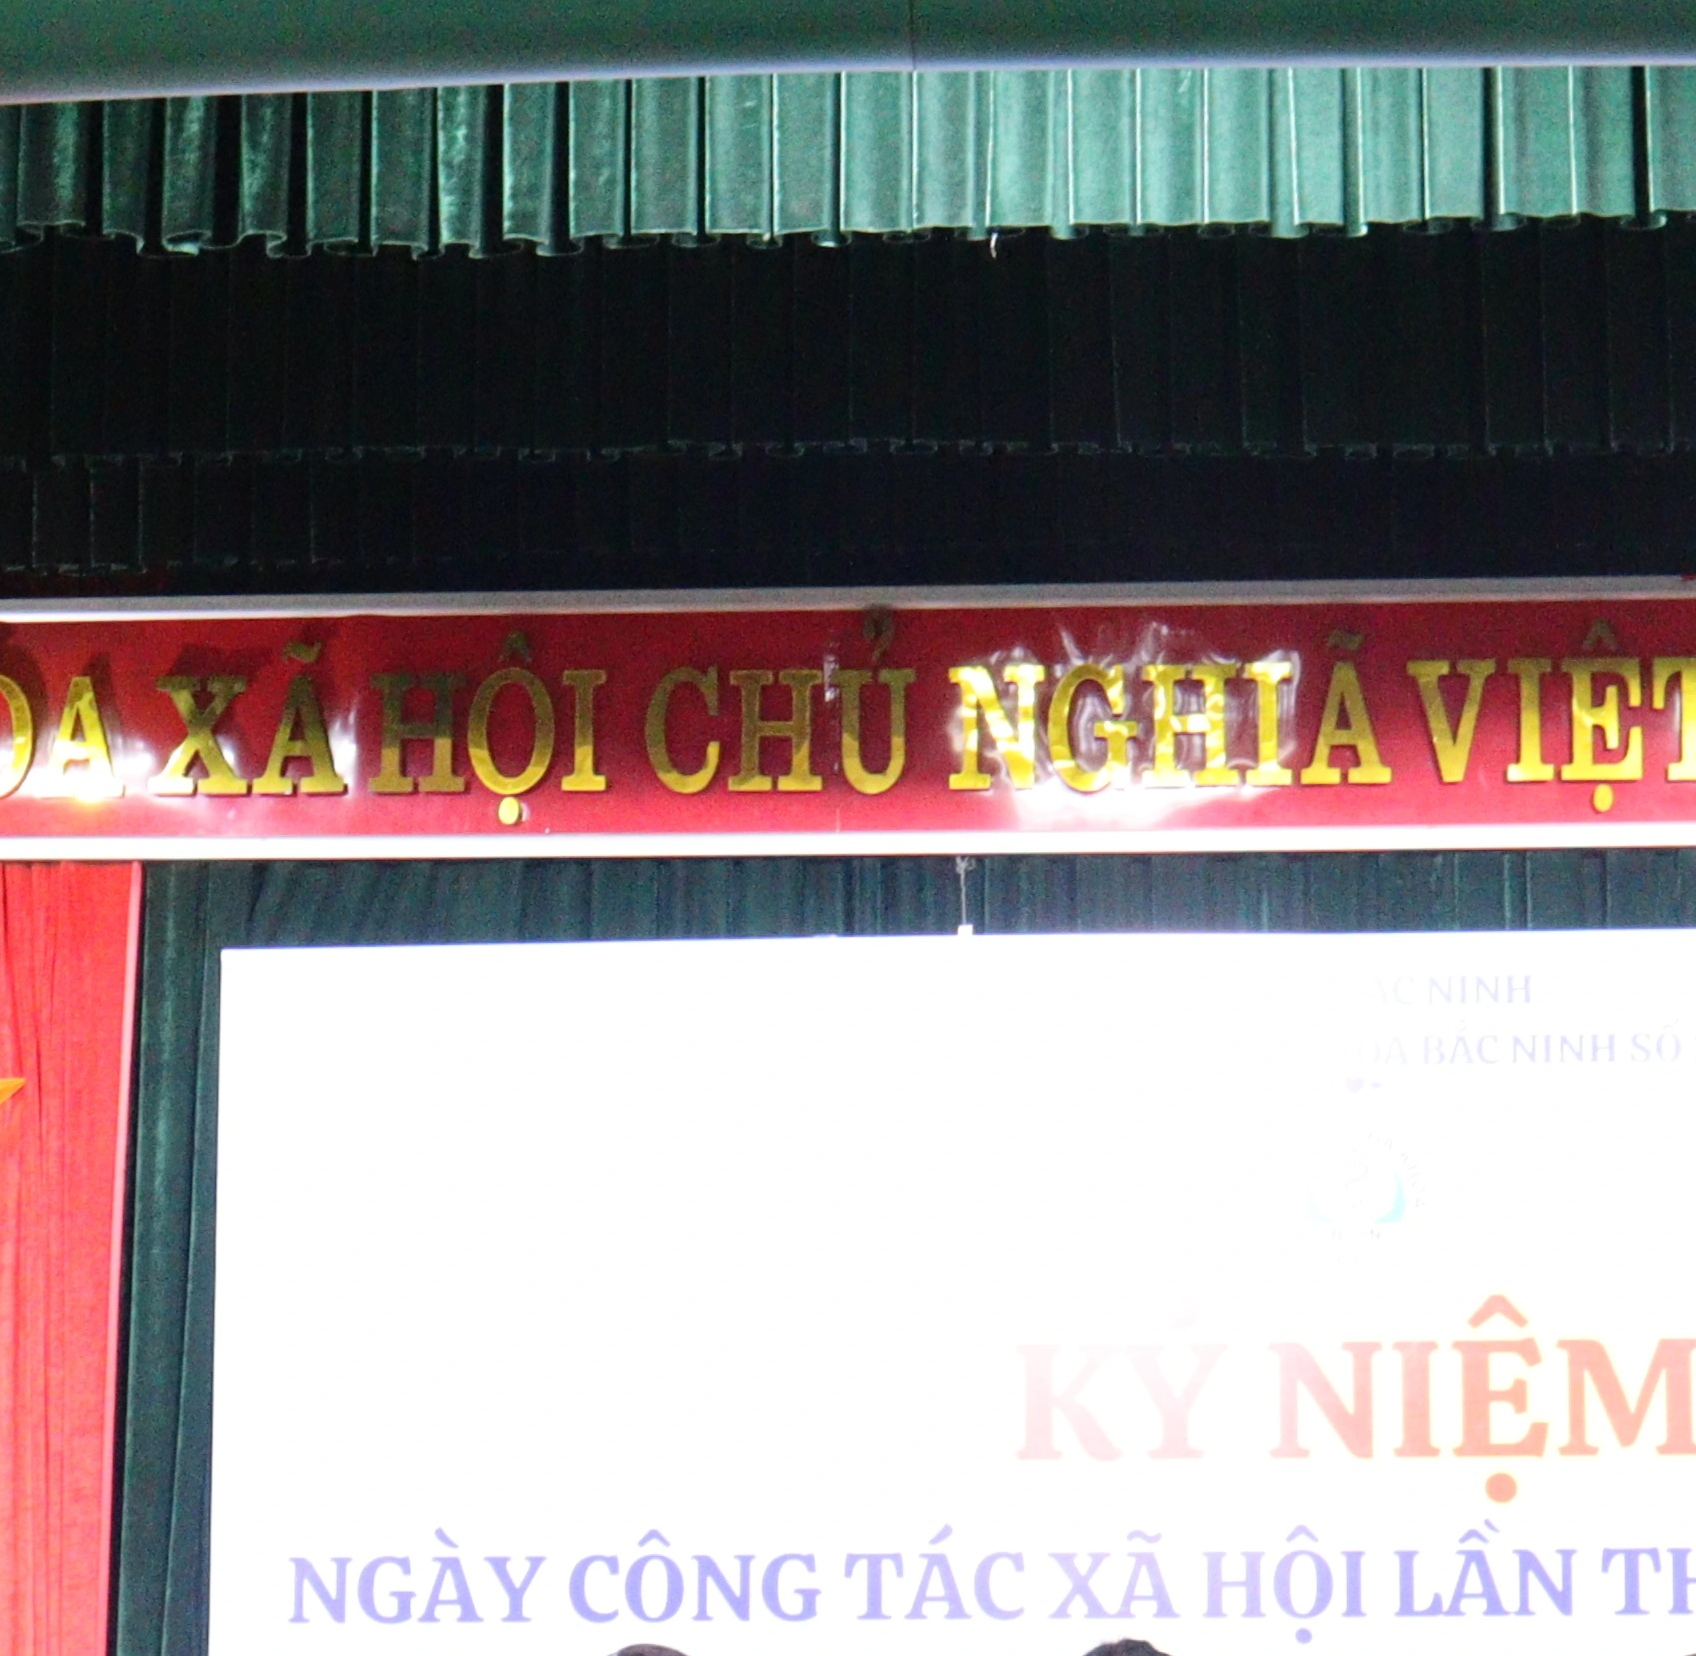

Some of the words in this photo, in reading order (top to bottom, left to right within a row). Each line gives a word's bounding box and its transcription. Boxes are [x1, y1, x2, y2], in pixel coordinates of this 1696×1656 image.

[148, 640, 347, 796] XÃ
[368, 630, 606, 825] HỘI
[645, 606, 915, 794] CHỦ
[1422, 1019, 1499, 1066] BẮC
[1512, 1034, 1616, 1064] NINH
[1631, 1018, 1682, 1063] SỐ
[1428, 975, 1532, 1005] NINH
[1015, 1293, 1228, 1460] KỶ
[288, 1527, 547, 1624] NGÀY
[568, 1529, 822, 1622] CÔNG
[844, 1523, 1025, 1621] TÁC
[1047, 1529, 1181, 1619] XÃ
[1202, 1525, 1367, 1644] HỘI
[1393, 1518, 1578, 1617] LẦN
